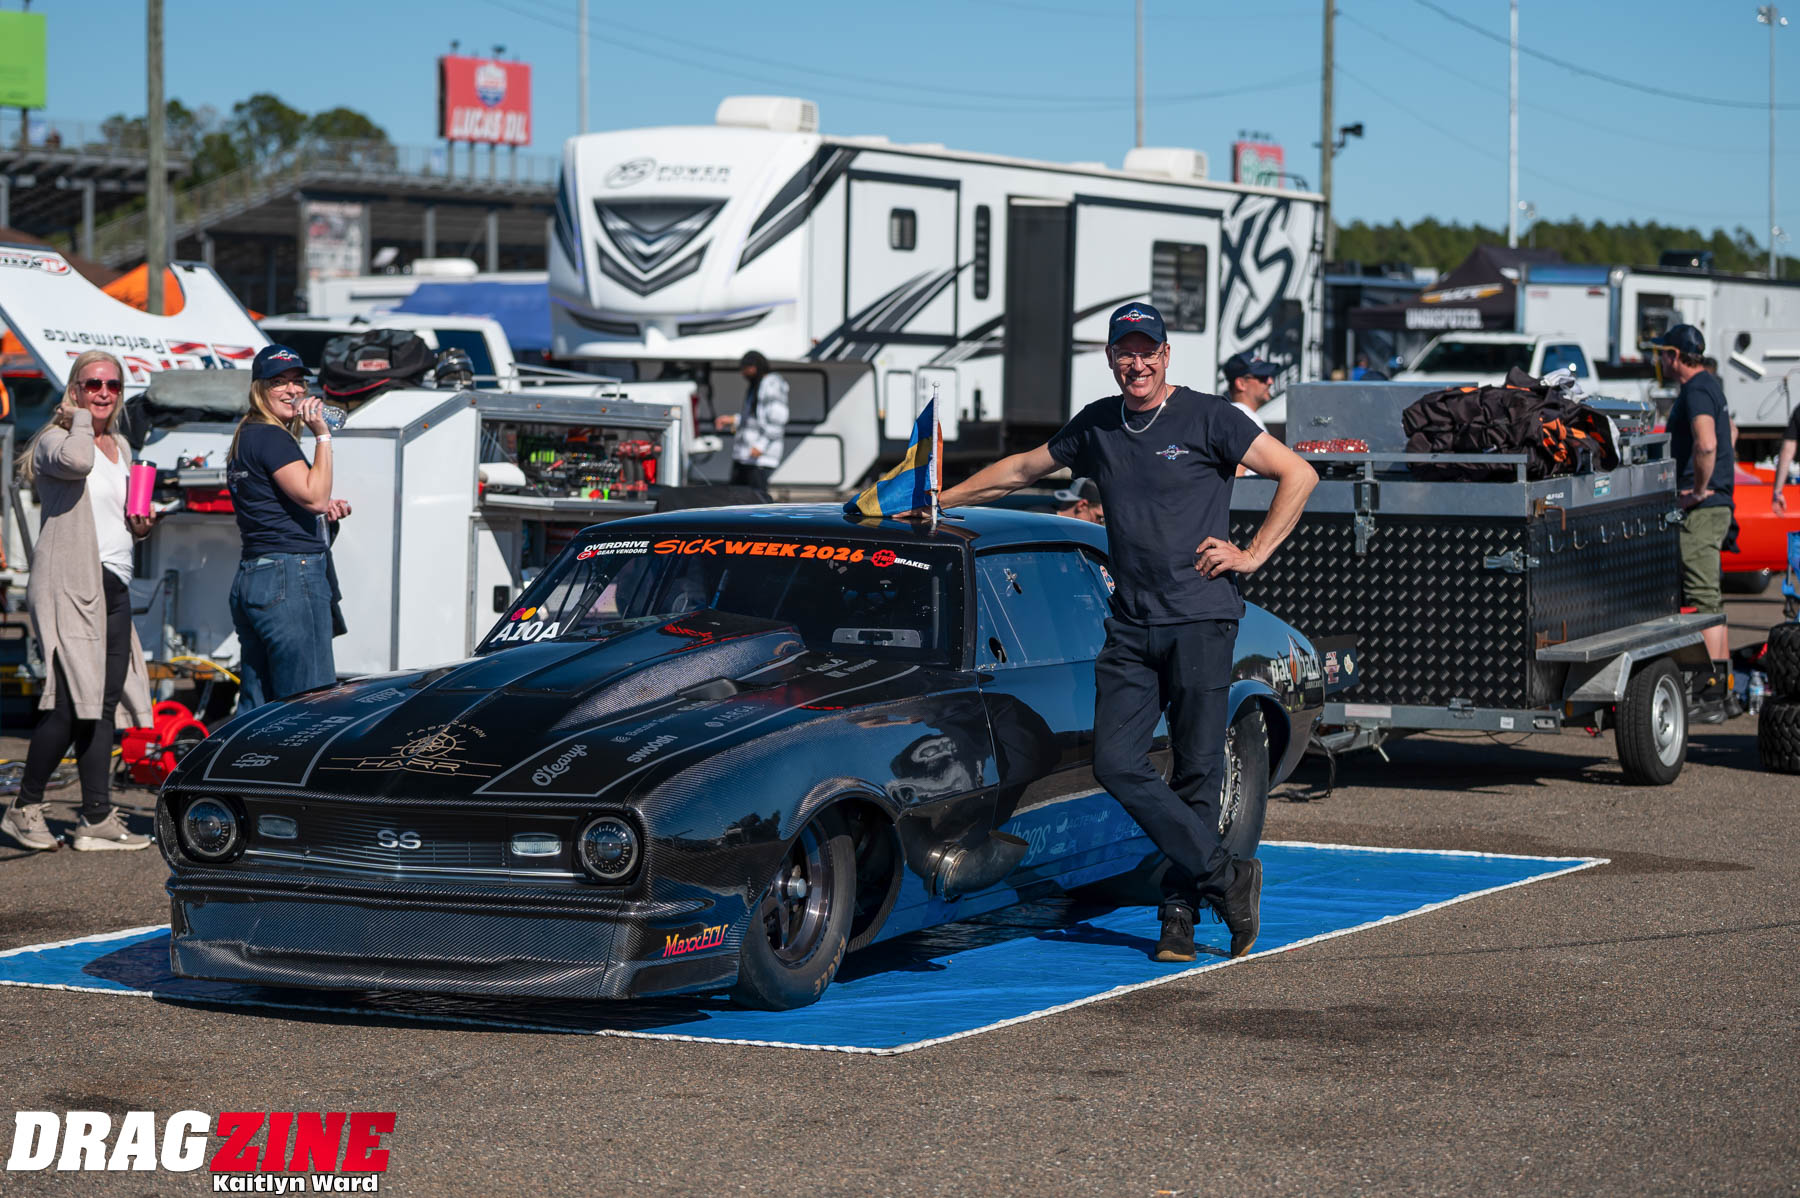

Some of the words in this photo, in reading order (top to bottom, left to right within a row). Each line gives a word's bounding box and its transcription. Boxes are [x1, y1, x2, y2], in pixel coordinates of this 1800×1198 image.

[448, 106, 502, 142] LUCAS
[657, 164, 732, 177] POWER
[43, 327, 165, 355] Performance
[584, 540, 650, 553] OVERDRIVE
[653, 539, 725, 556] SICK
[725, 541, 801, 558] WEEK
[799, 544, 866, 563] 2026
[893, 557, 931, 570] BRAKES
[489, 621, 560, 644] A10A
[357, 758, 461, 773] HARR
[376, 829, 422, 851] SS
